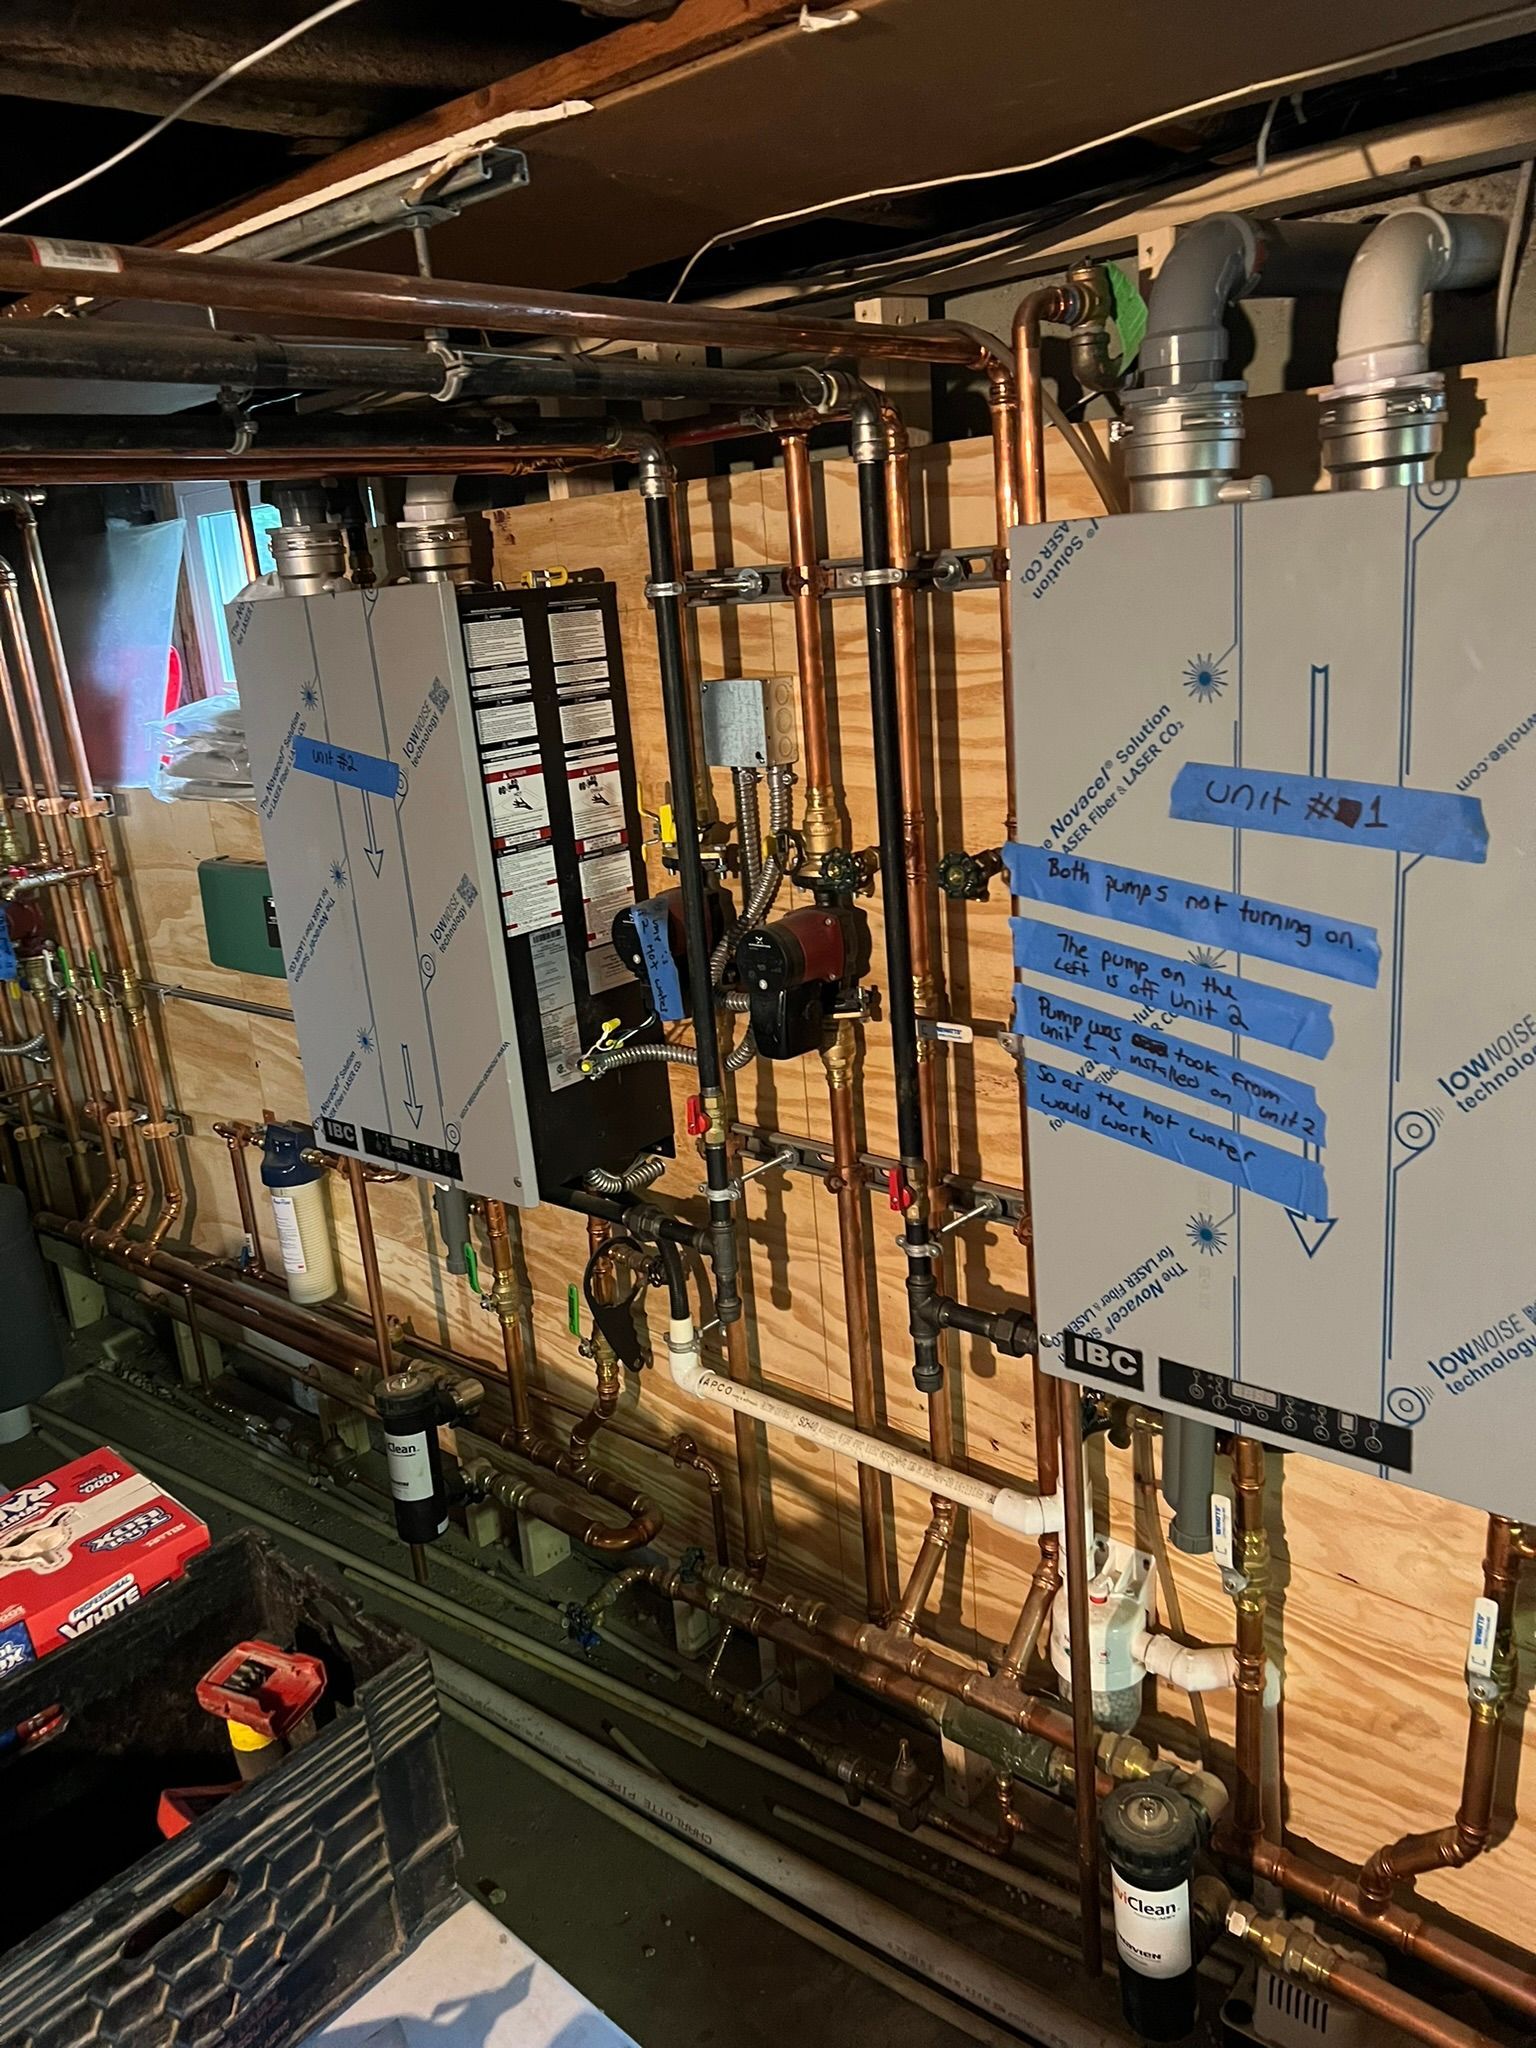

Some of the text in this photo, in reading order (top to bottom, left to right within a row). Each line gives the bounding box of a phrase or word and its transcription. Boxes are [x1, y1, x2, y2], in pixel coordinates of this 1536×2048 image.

[1032, 536, 1084, 599] Solution
[1038, 520, 1070, 560] ASER
[410, 711, 440, 768] technology
[1115, 703, 1171, 765] Solution
[1060, 822, 1092, 855] ASER
[1087, 791, 1118, 826] Fiber
[1122, 743, 1163, 787] LASER
[1047, 857, 1090, 885] Both
[1104, 873, 1169, 903] pumps
[1185, 892, 1228, 915] not
[1239, 898, 1312, 947] turning
[1057, 933, 1239, 1001] The pump on the
[1106, 974, 1120, 988] is
[1129, 978, 1160, 1001] off
[1226, 1003, 1249, 1031] 2
[1037, 995, 1084, 1032] Pump
[1173, 1046, 1220, 1077] took
[1456, 1045, 1536, 1113] technolo
[326, 1120, 356, 1143] IBC
[1036, 1063, 1057, 1084] So
[1061, 1078, 1085, 1094] as
[1095, 1090, 1129, 1117] the
[1142, 1104, 1180, 1130] hot
[1188, 1127, 1257, 1163] water
[1040, 1092, 1154, 1146] would work
[1210, 1087, 1232, 1104] on
[1302, 1117, 1316, 1136] 2
[1122, 1257, 1160, 1289] LASER
[1156, 1245, 1175, 1263] for
[1161, 1261, 1189, 1283] The
[1099, 1282, 1128, 1308] Fiber
[1073, 1337, 1139, 1377] IBC
[0, 1501, 53, 1531] WHIT
[57, 1584, 141, 1640] WHITE
[72, 1575, 132, 1619] PROFESSIONAL
[606, 1777, 713, 1846] CHARLOTTE PIPE
